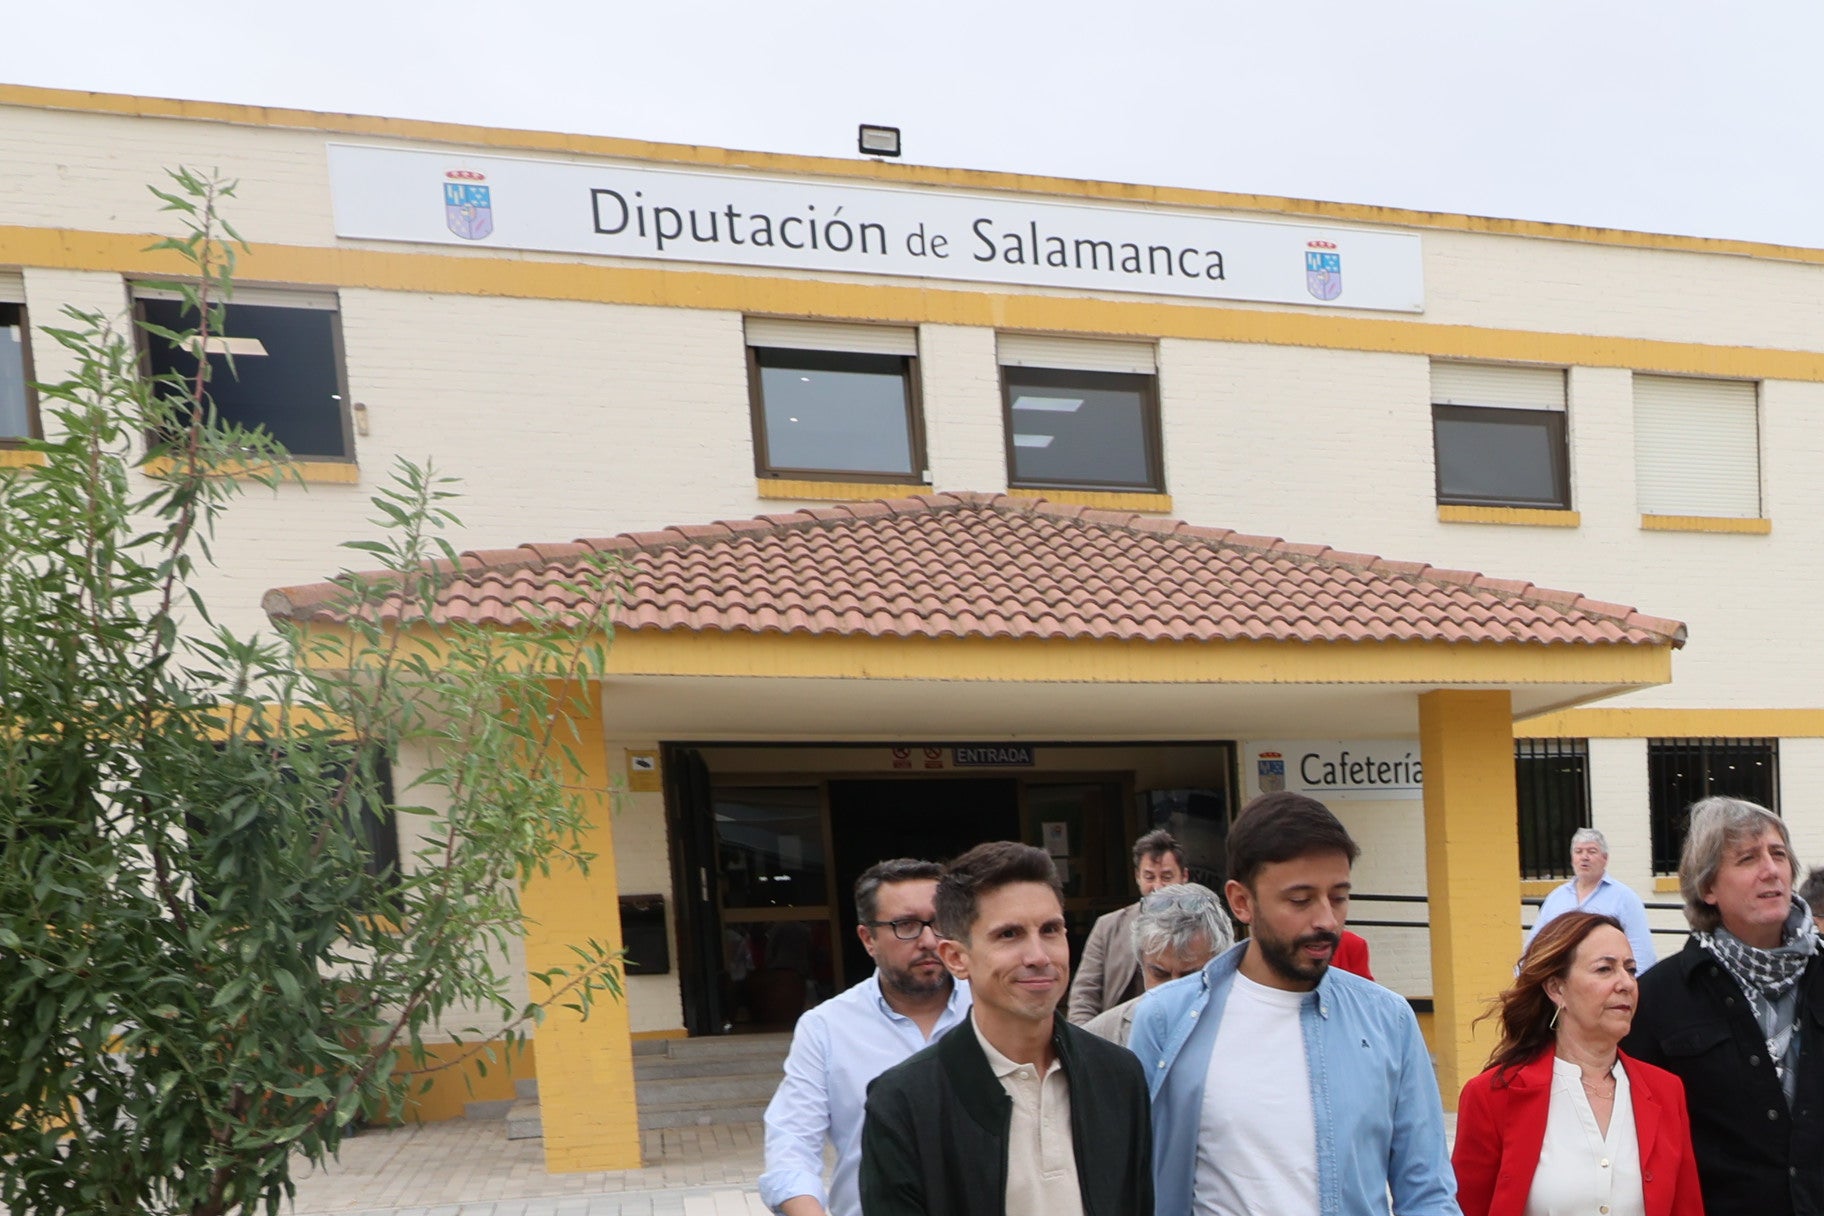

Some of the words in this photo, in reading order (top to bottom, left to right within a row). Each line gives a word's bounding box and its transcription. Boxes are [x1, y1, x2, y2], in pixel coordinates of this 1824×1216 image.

[589, 187, 888, 256] Diputación
[906, 222, 949, 259] de
[972, 218, 1227, 282] Salamanca
[957, 747, 1030, 763] ENTRADA
[1300, 751, 1424, 786] Cafetería
